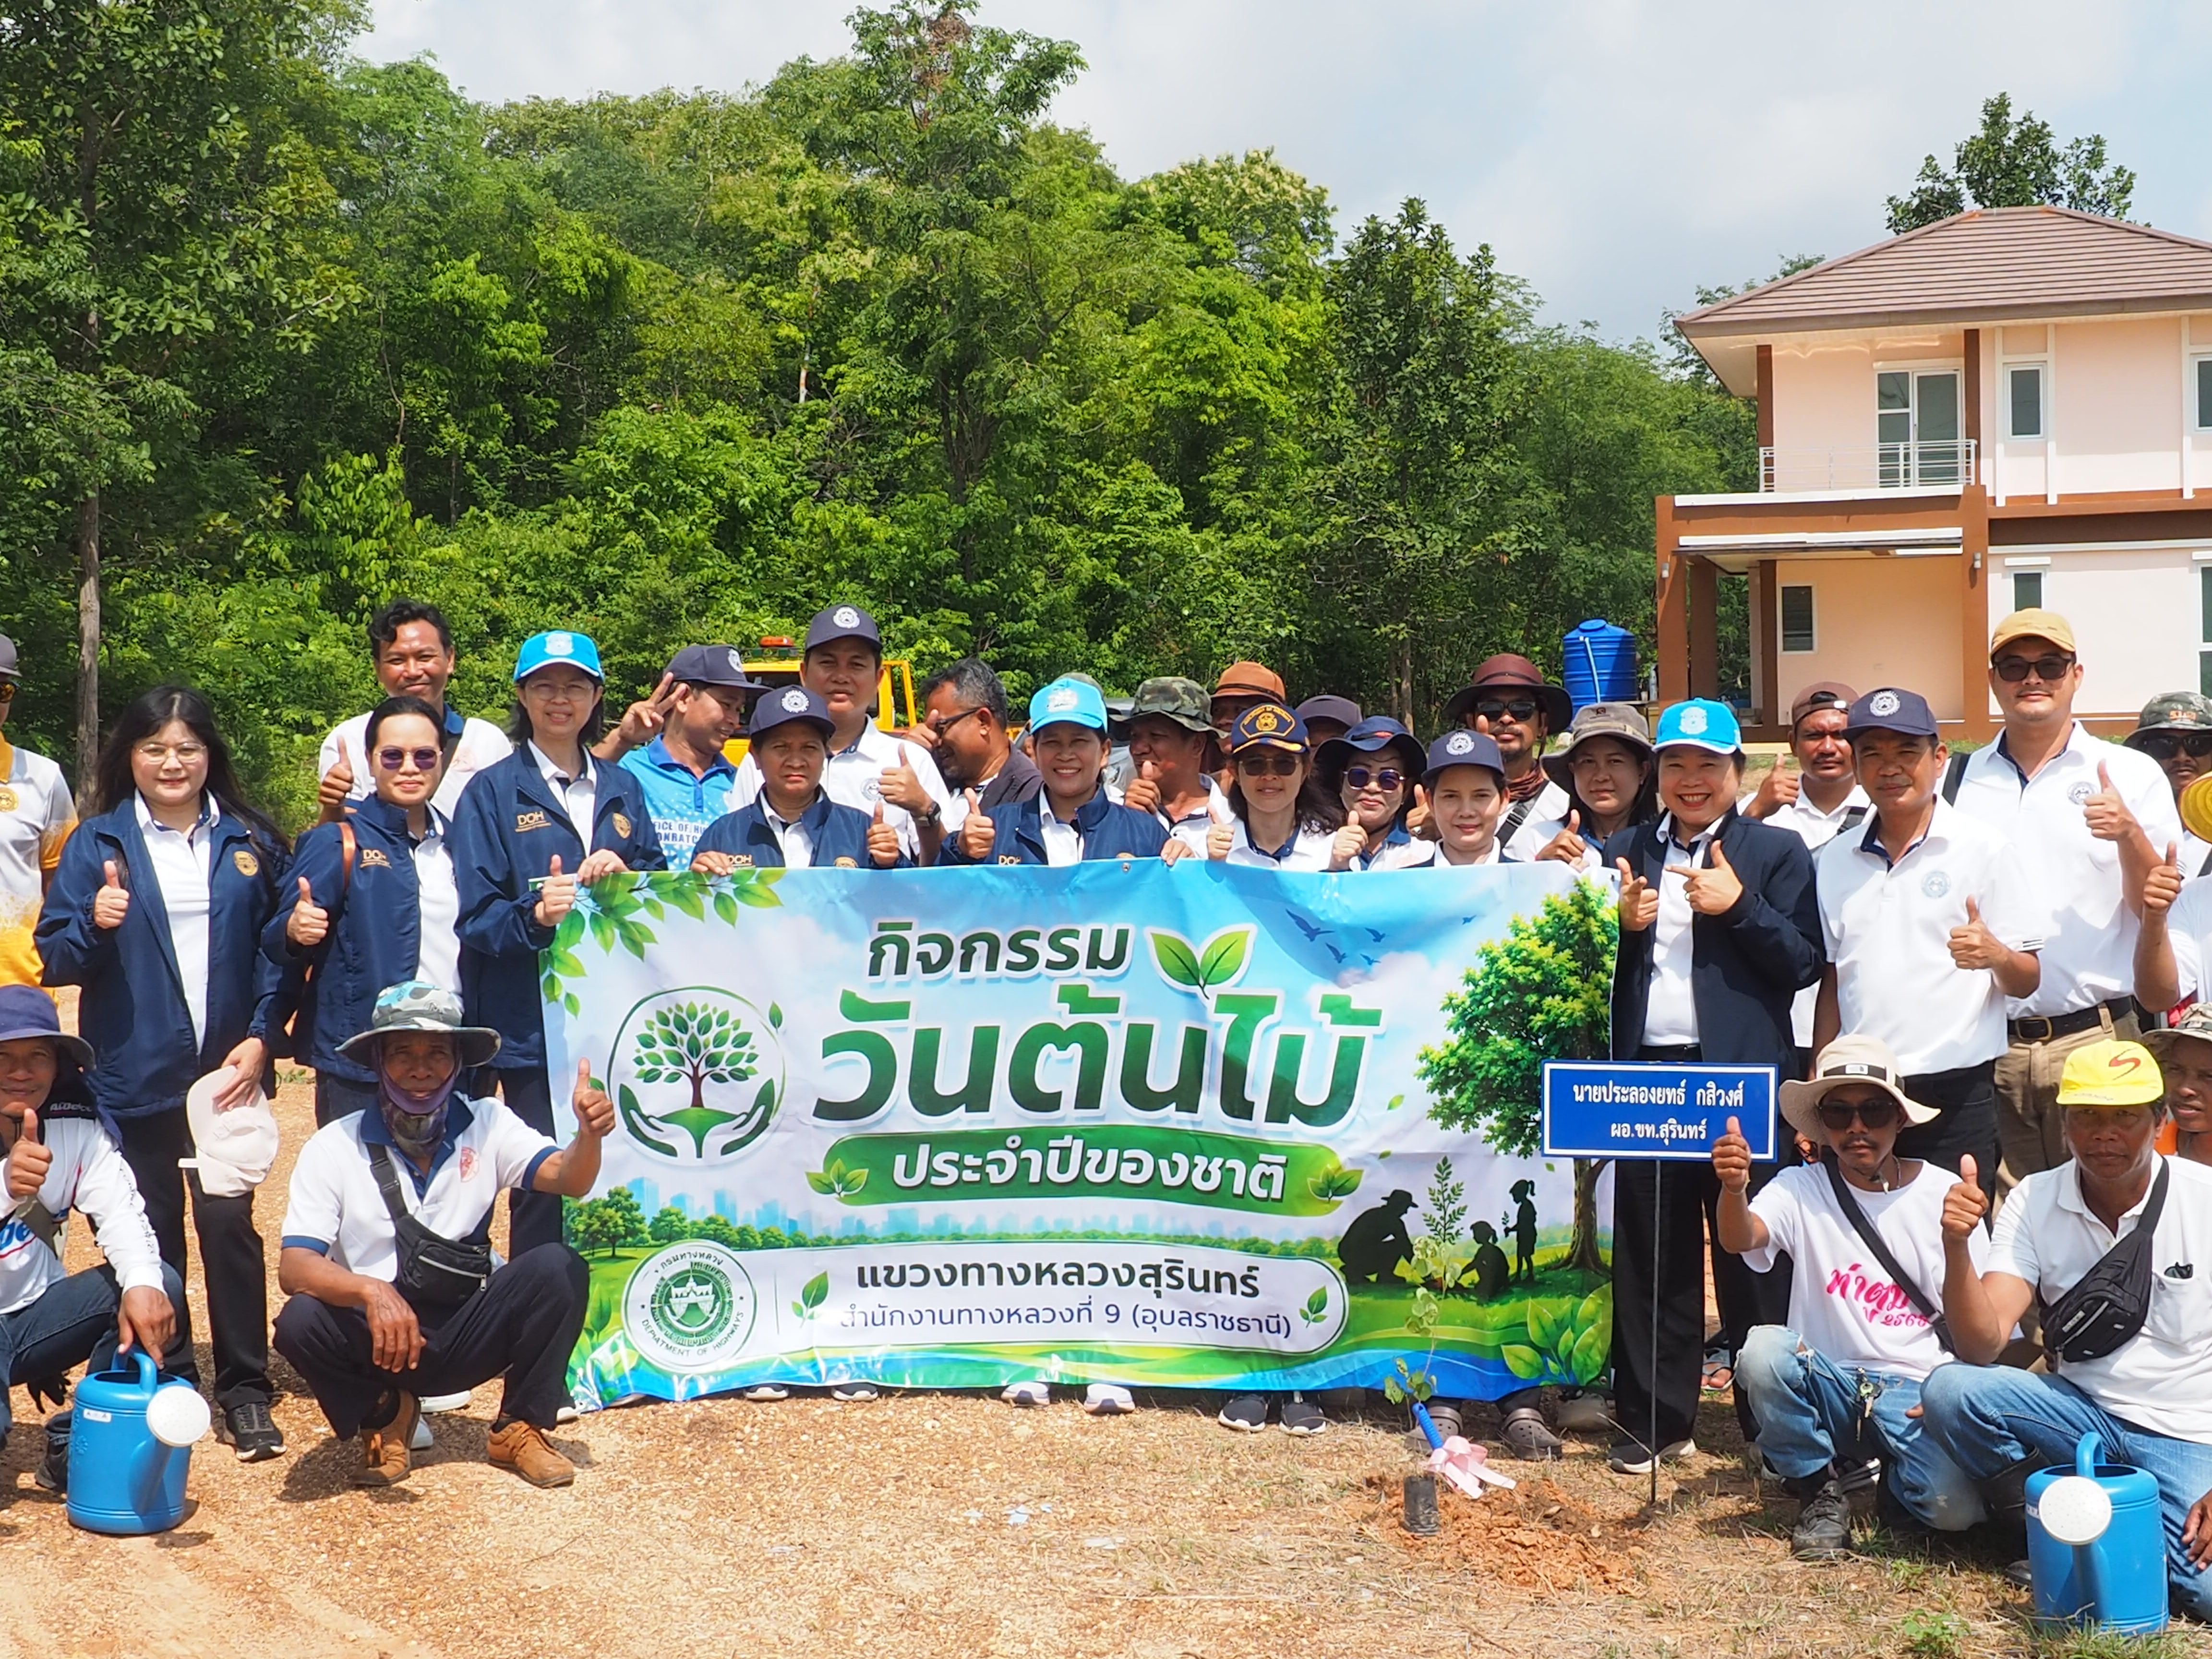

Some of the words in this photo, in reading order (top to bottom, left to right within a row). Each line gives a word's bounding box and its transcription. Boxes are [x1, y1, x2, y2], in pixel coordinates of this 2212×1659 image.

[517, 811, 545, 825] DOH
[678, 823, 689, 832] OF
[868, 921, 1130, 977] กิจกรรม
[812, 984, 1383, 1127] วันต้นไม้
[1696, 1079, 1744, 1107] กสิวงศ์
[1611, 1117, 1707, 1146] ผอ.ขท.สุรินทร์
[891, 1134, 1288, 1201] ประจำปีของชาติ
[661, 1251, 723, 1269] กรมทางหลวง
[857, 1258, 1260, 1299] แขวงทางหลวงสุรินทร์
[841, 1295, 1092, 1327] สำนักงานทางหลวงที่
[1105, 1304, 1120, 1323] 9
[1132, 1304, 1291, 1339] (อุบลราชธานี)
